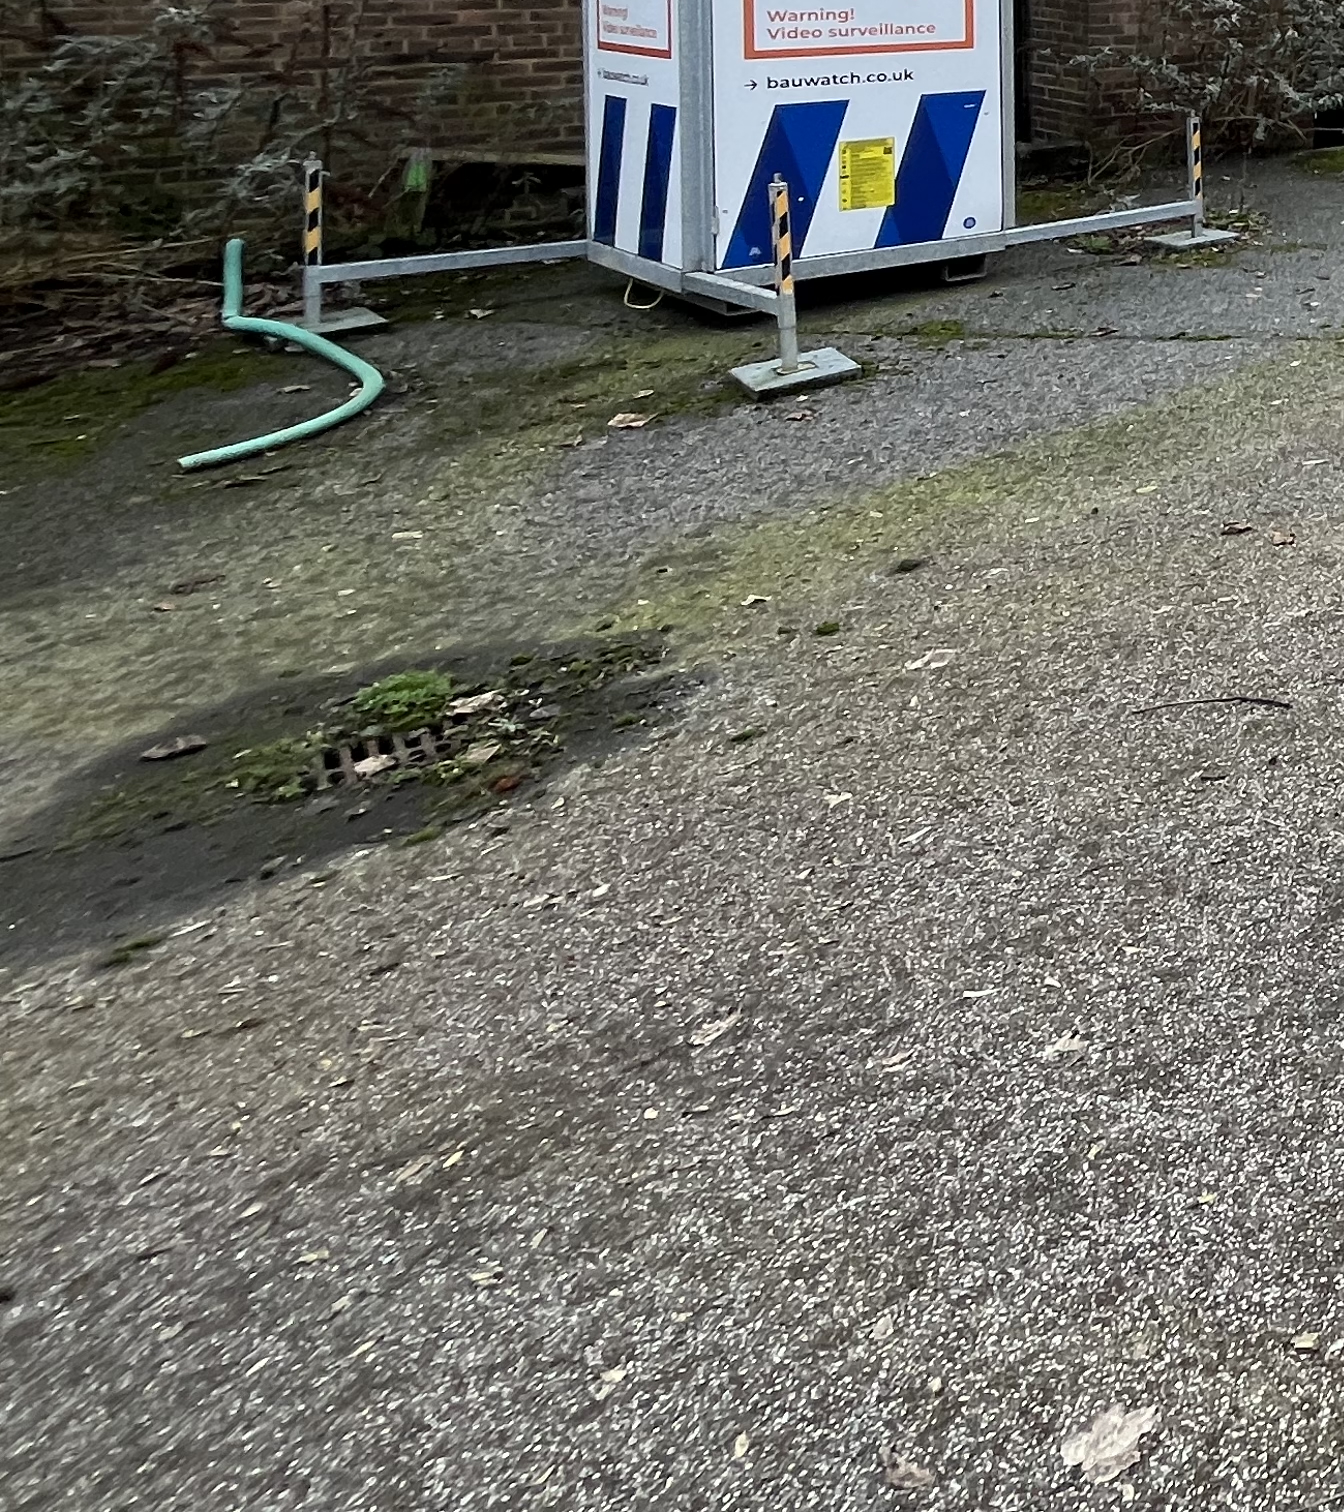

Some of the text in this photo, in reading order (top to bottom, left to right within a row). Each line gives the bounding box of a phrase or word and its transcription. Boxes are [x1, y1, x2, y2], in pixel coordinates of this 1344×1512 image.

[766, 7, 855, 23] Warning!
[766, 23, 937, 39] Video surveillance
[766, 68, 914, 90] bauwatch.co.uk
